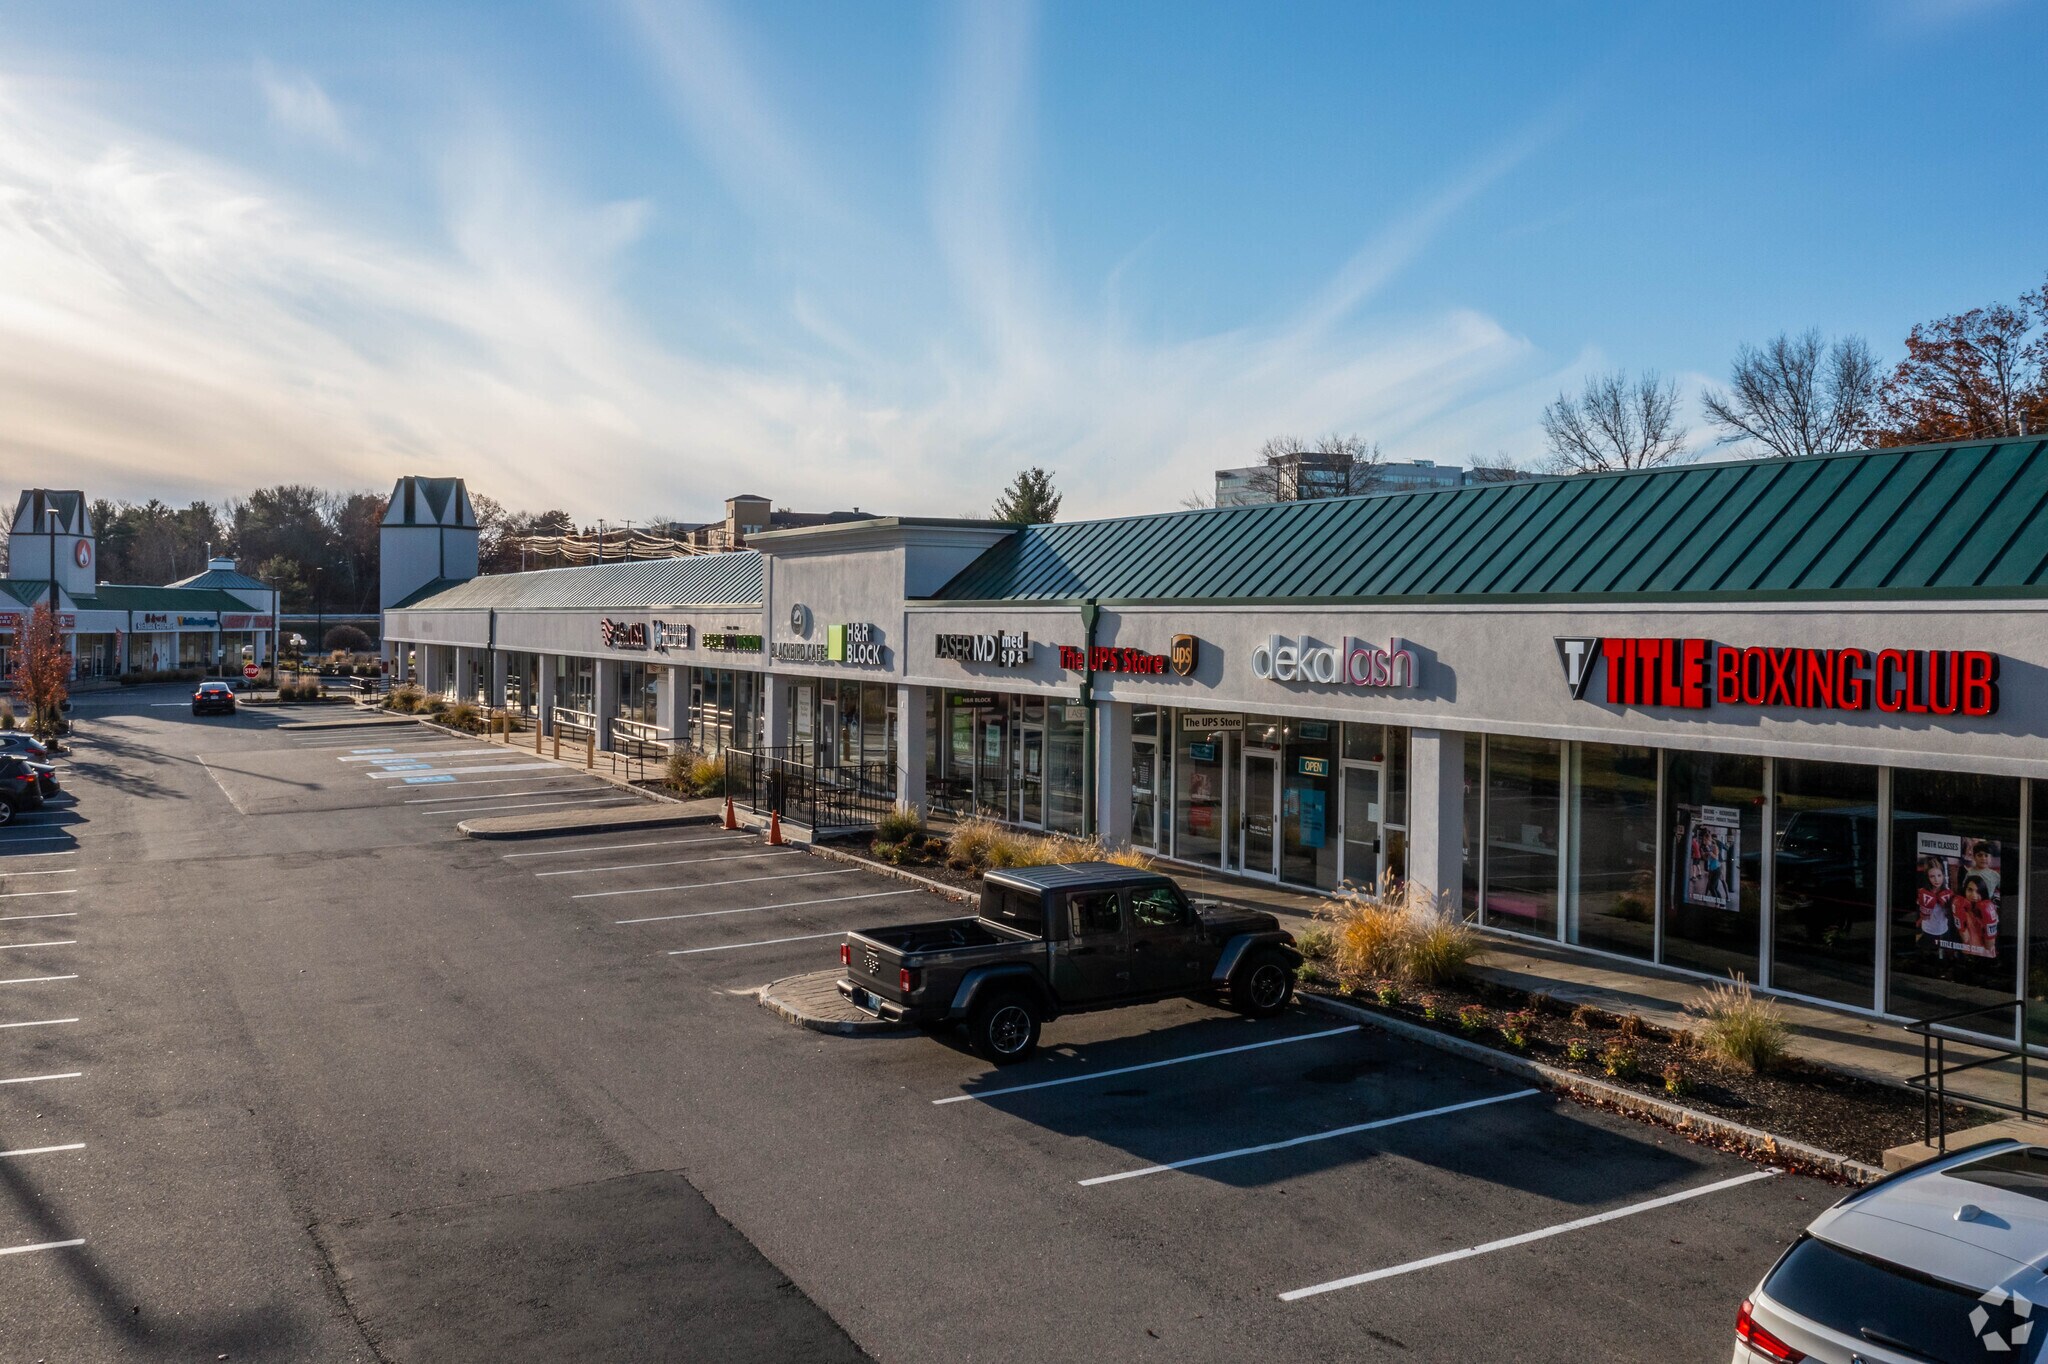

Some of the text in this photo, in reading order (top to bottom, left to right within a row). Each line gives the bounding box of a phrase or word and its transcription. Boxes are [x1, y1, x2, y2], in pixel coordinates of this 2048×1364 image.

[846, 623, 869, 642] H&R
[1001, 631, 1025, 649] med
[771, 643, 806, 660] BLACKBIRD
[846, 644, 881, 665] BLOCK
[935, 634, 996, 661] LASER MD
[1001, 650, 1024, 668] spa
[1059, 646, 1165, 674] The UPS Store
[1172, 647, 1191, 670] ups
[244, 667, 259, 675] STOP
[1602, 638, 1706, 709] TITLE
[1717, 647, 1864, 711] BOXING
[1875, 649, 1994, 716] CLUB
[1067, 708, 1086, 719] LASE
[1185, 717, 1241, 728] The UPS Store
[1304, 760, 1322, 773] OPEN
[1921, 839, 1959, 852] YOUTH CLASSES
